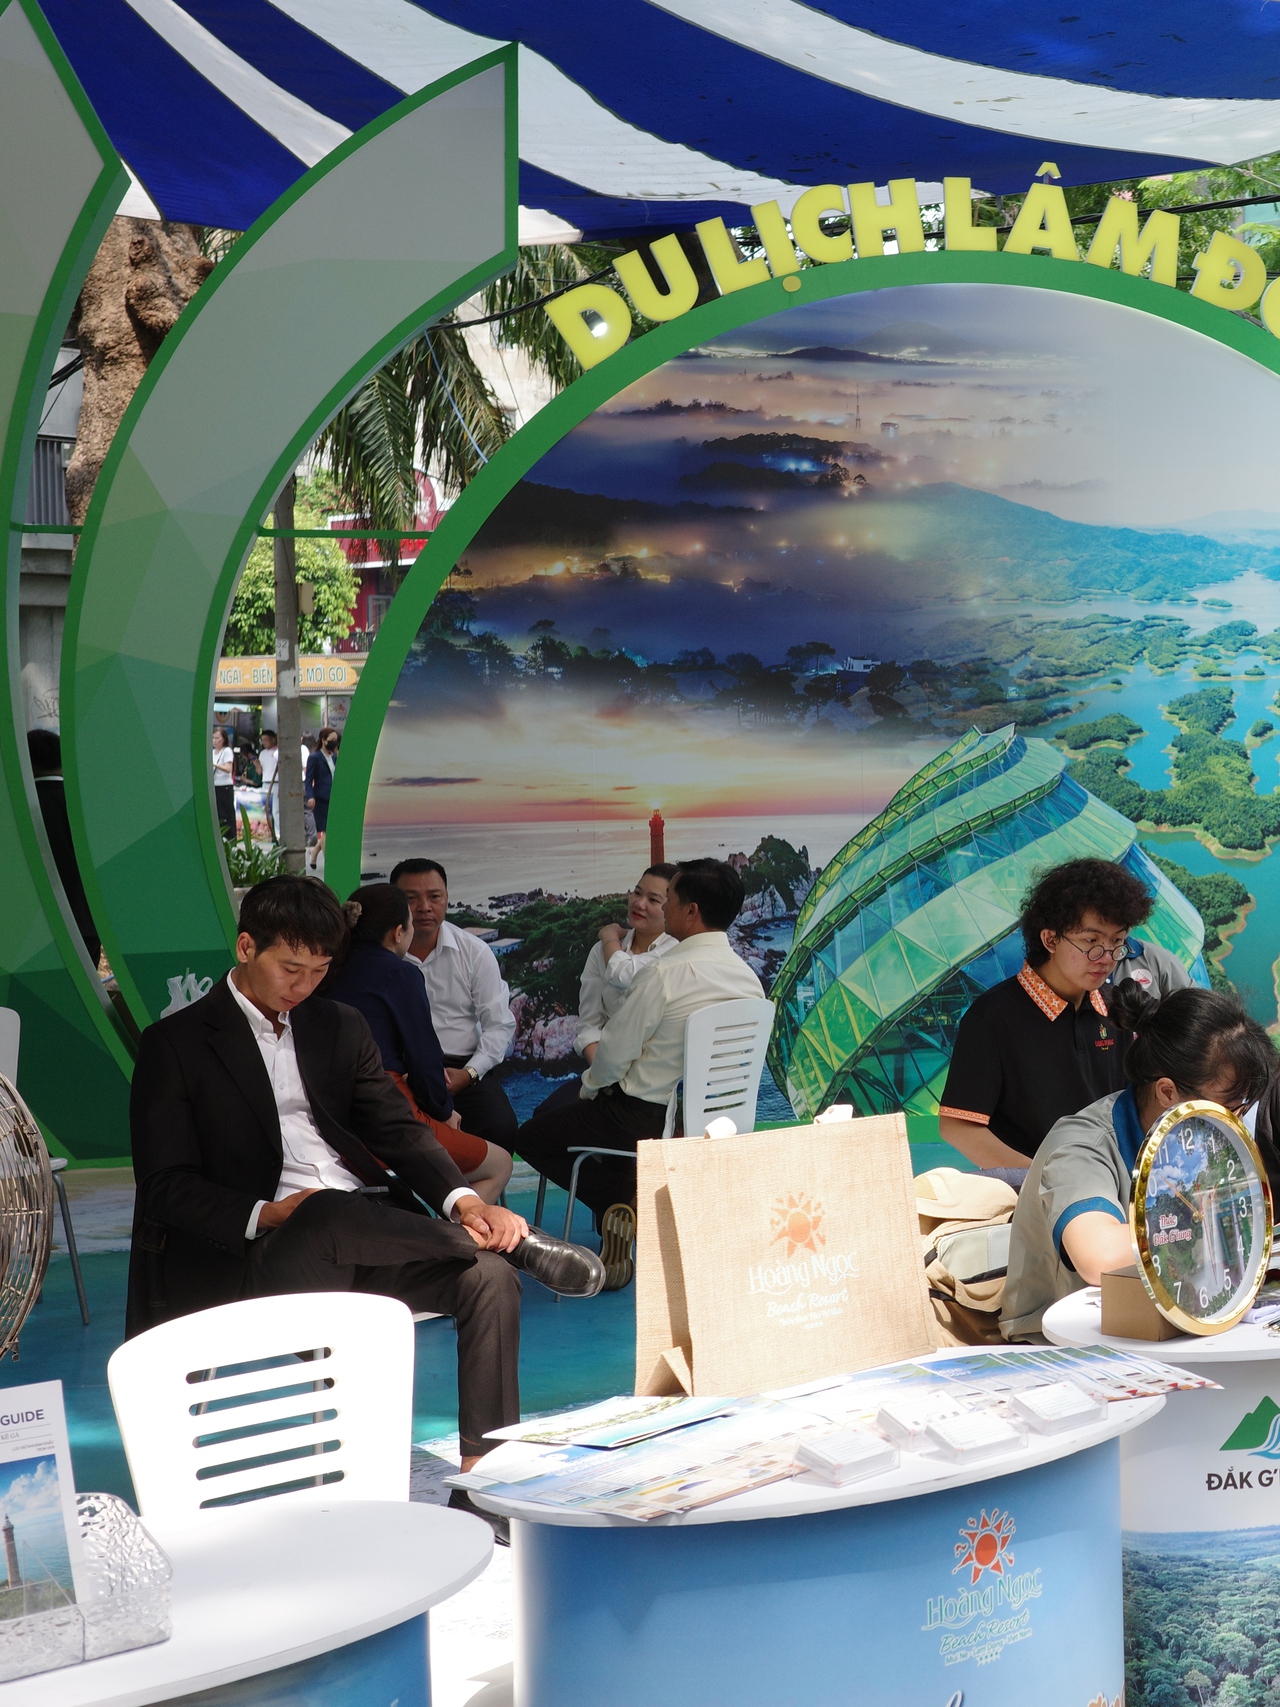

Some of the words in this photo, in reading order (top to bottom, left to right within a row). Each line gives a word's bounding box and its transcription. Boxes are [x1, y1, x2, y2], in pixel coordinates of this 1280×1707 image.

[544, 233, 700, 371] DU
[693, 178, 922, 294] LỊCH
[943, 161, 1182, 287] LÂM
[1178, 1127, 1195, 1151] 12
[1226, 1159, 1236, 1181] 2
[1147, 1176, 1158, 1197] 0
[1239, 1196, 1248, 1218] 3
[1237, 1235, 1245, 1256] 4
[748, 1259, 810, 1295] Hoàng
[811, 1252, 860, 1285] Ngọc
[1223, 1268, 1232, 1291] 5
[766, 1293, 806, 1318] Beach
[807, 1287, 849, 1308] Resort
[1173, 1281, 1182, 1304] 7
[1199, 1286, 1209, 1309] 6
[0, 1409, 44, 1426] GUIDE
[921, 1587, 994, 1630] Hoàng
[997, 1567, 1042, 1611] Ngọc
[939, 1621, 985, 1655] Beach
[986, 1607, 1030, 1638] Resort
